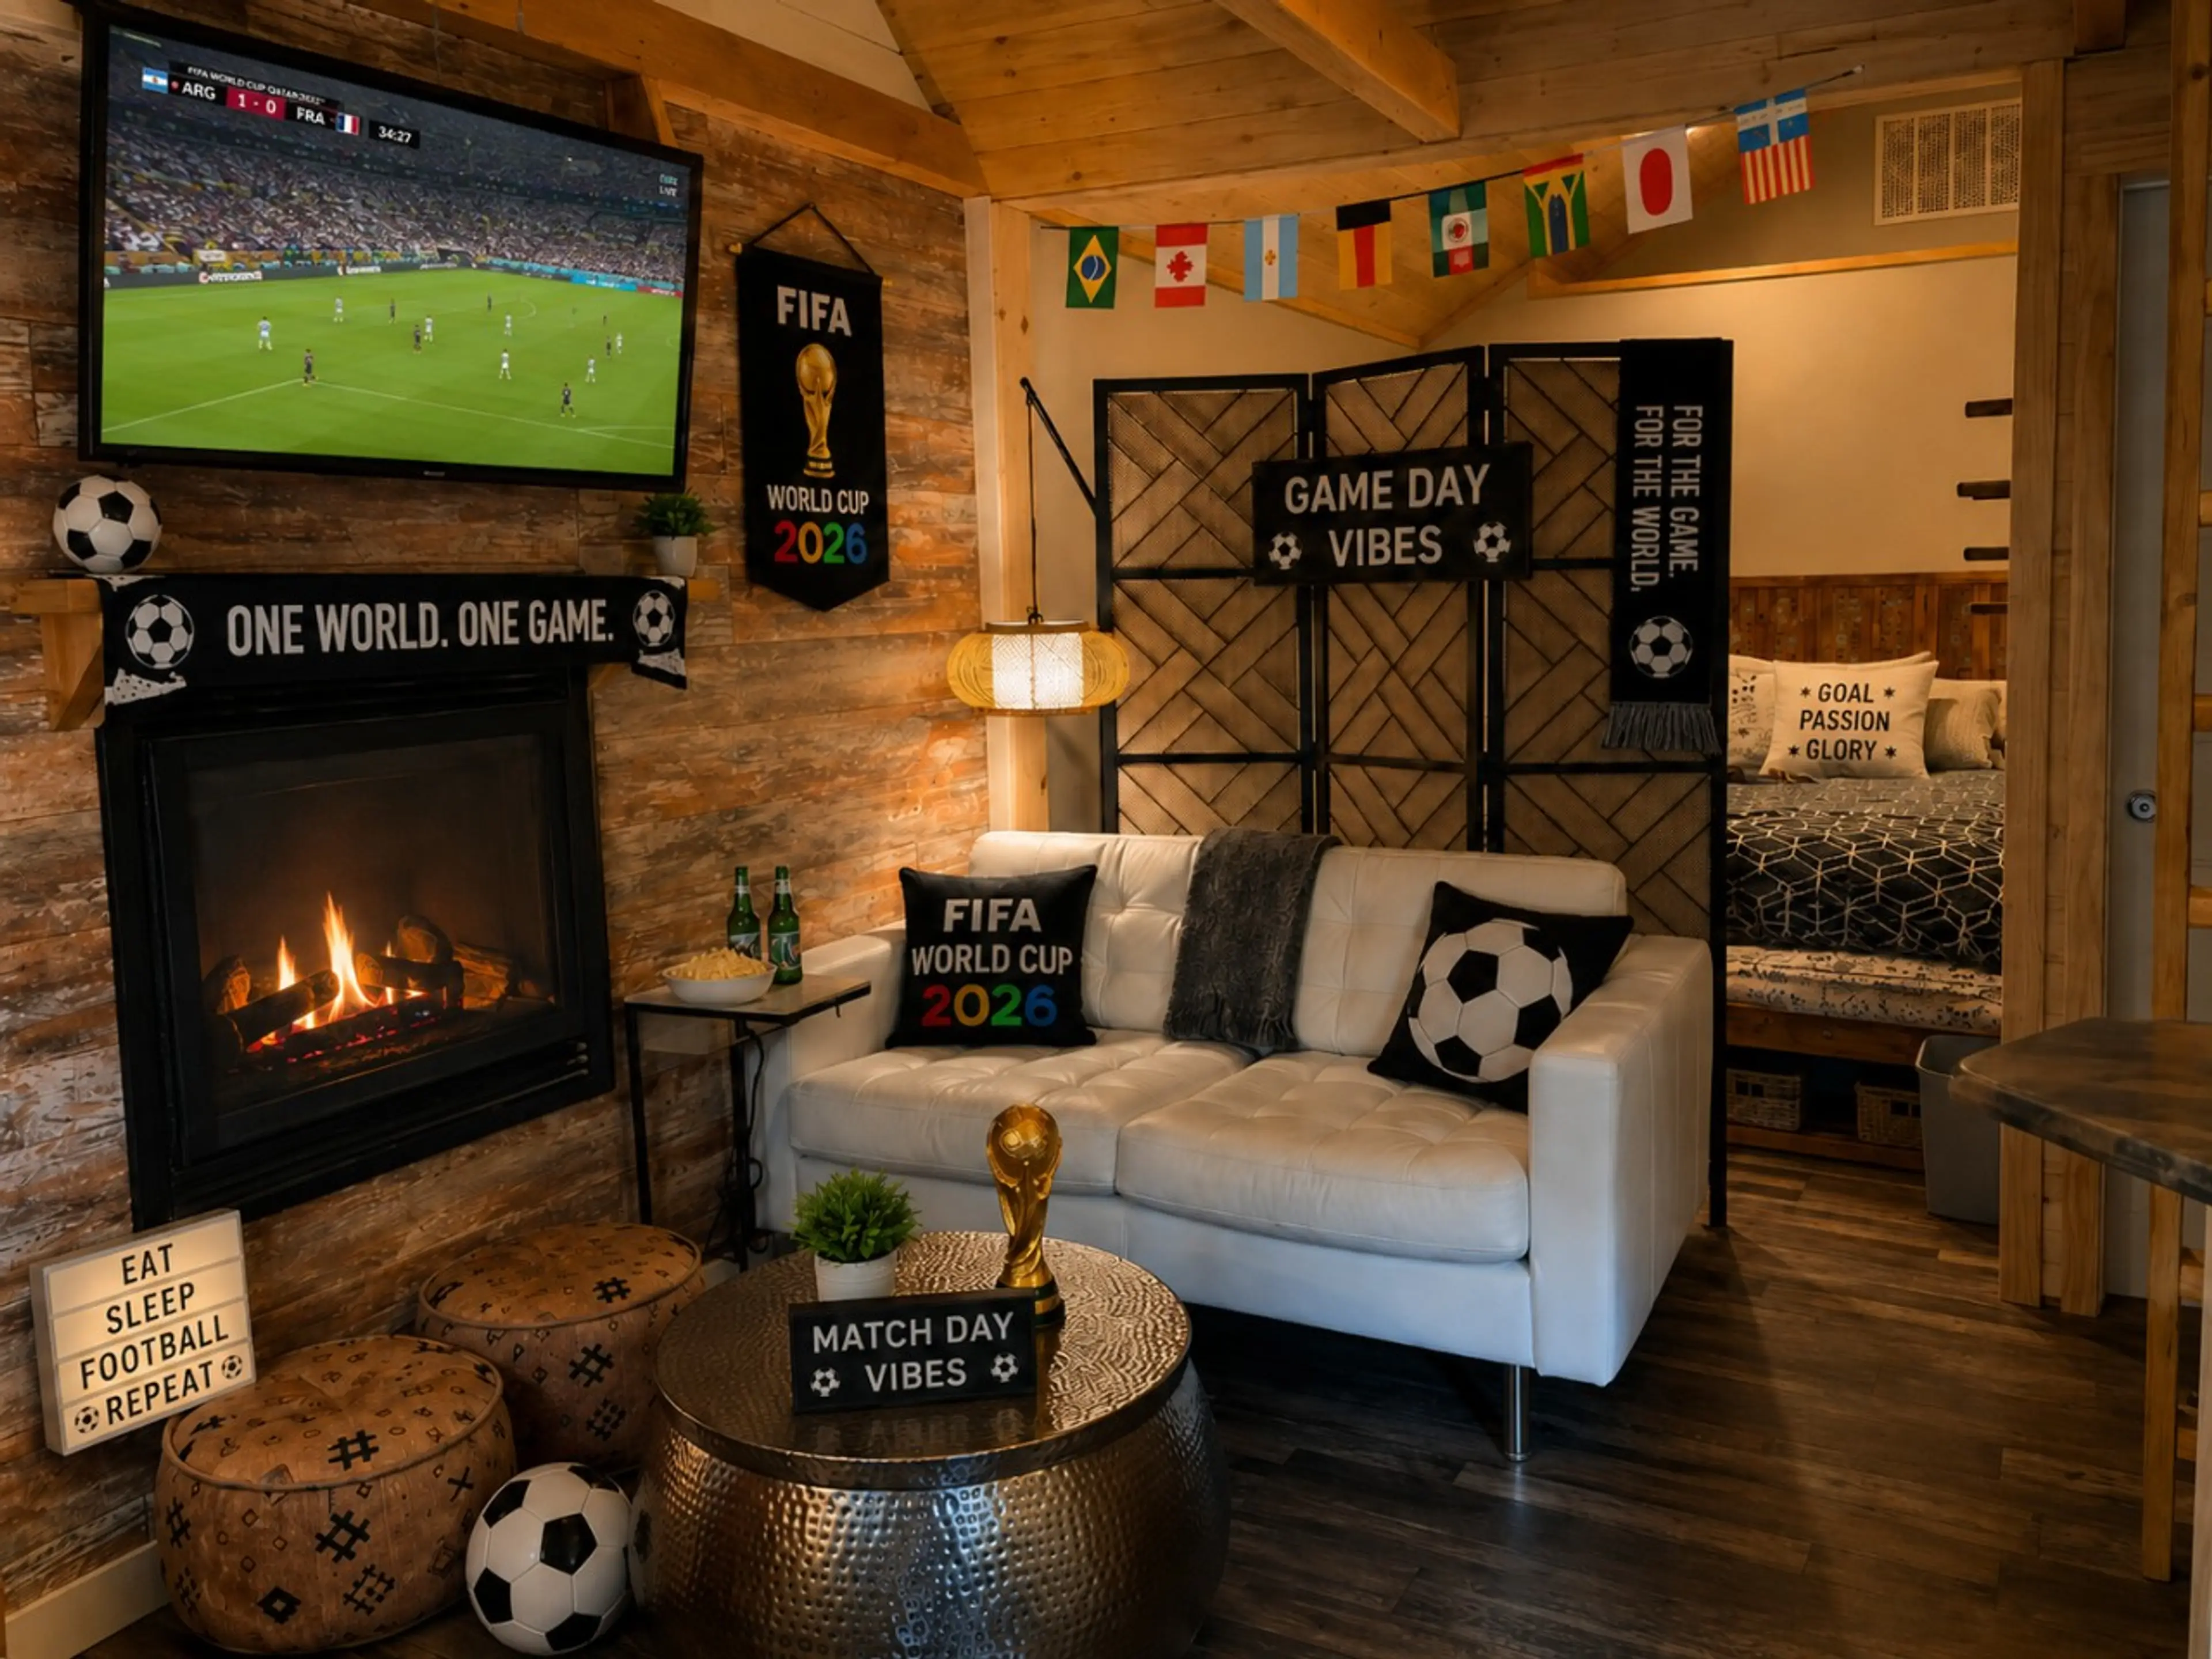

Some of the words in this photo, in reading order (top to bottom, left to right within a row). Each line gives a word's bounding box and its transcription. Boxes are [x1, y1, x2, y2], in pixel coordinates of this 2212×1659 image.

[181, 82, 216, 100] ARG
[238, 93, 245, 108] 1
[266, 100, 276, 114] 0
[297, 107, 325, 125] FRA
[778, 286, 852, 336] FIFA
[1634, 406, 1664, 447] FOR
[1672, 406, 1703, 447] FOR
[1285, 471, 1393, 514] GAME
[1408, 464, 1490, 508] DAY
[1633, 454, 1662, 497] THE
[1671, 454, 1701, 498] THE
[767, 484, 833, 513] WORLD
[837, 489, 869, 514] CUP
[774, 520, 868, 564] 2026
[1328, 525, 1442, 567] VIBES
[1669, 507, 1699, 578] GAME.
[227, 604, 304, 657] ONE
[315, 602, 448, 653] WORLD.
[459, 600, 520, 647] ONE
[528, 599, 614, 644] GAME.
[1818, 683, 1875, 703] GOAL
[1800, 710, 1890, 732] PASSION
[1806, 738, 1877, 761] GLORY
[944, 898, 1042, 932] FIFA
[912, 944, 1010, 976] WORLD
[1019, 944, 1073, 975] CUP
[922, 984, 1058, 1027] 2026
[121, 1243, 173, 1286] EAT
[105, 1282, 195, 1335] SLEEP
[79, 1315, 229, 1391] FOOTBALL
[813, 1317, 931, 1354] MATCH
[946, 1312, 1013, 1343] DAY
[105, 1360, 213, 1425] REPEAT
[865, 1358, 967, 1392] VIBES
